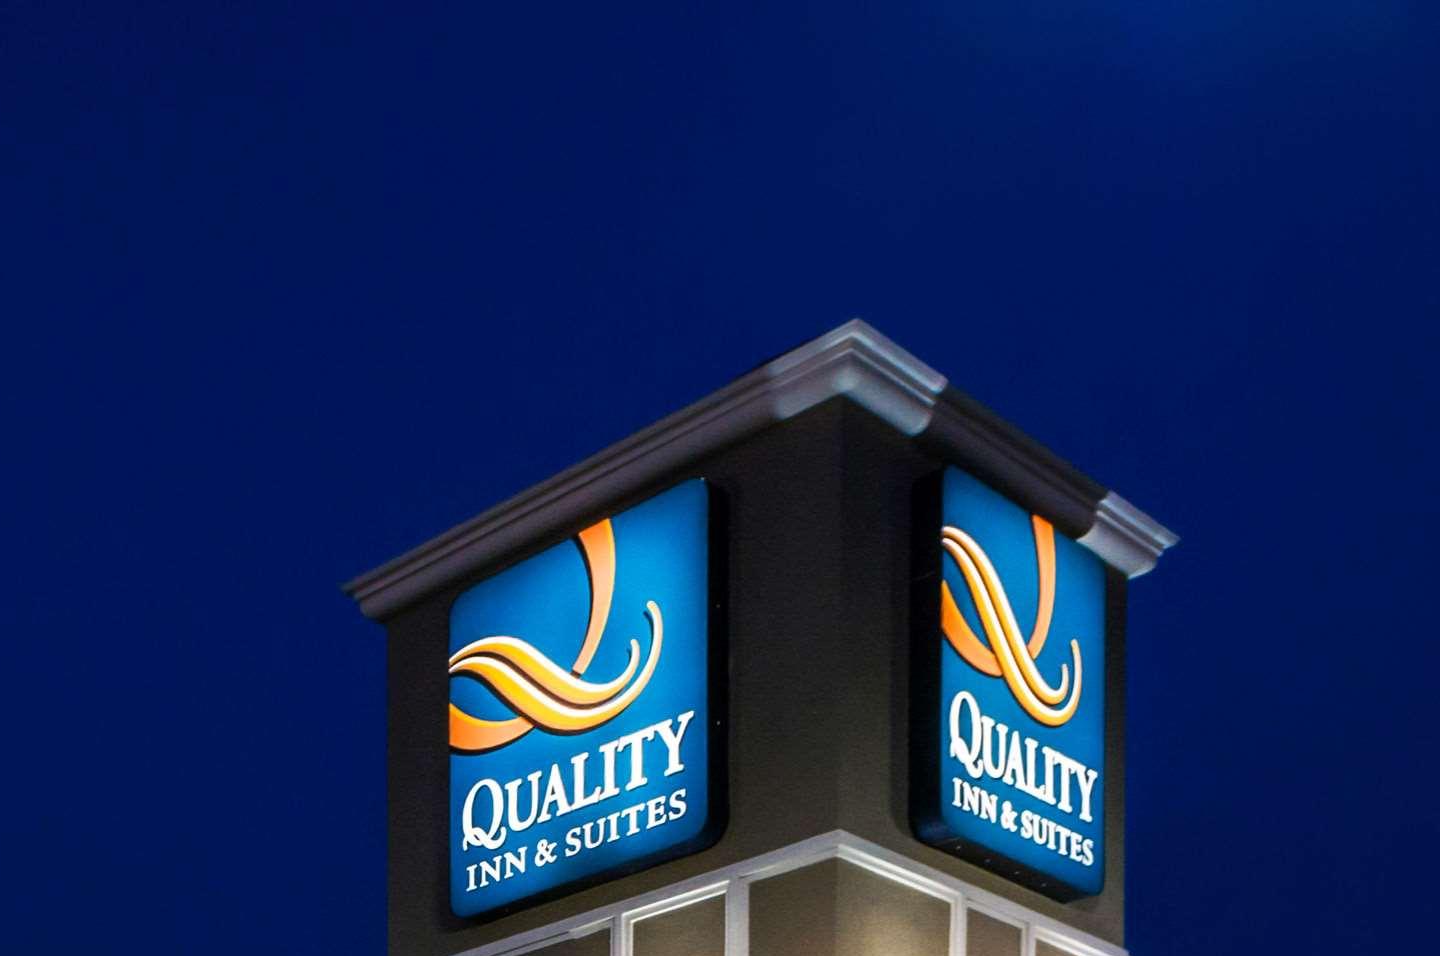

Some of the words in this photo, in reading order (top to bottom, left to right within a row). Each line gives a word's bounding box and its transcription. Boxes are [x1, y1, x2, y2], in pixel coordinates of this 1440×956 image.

[462, 710, 694, 851] QUALITY
[949, 691, 1098, 822] QUALITY
[466, 846, 528, 892] INN
[534, 839, 557, 867] &
[564, 789, 687, 857] SUITES
[952, 777, 998, 823] INN
[1000, 801, 1017, 832] &
[1021, 810, 1094, 866] SUITES
